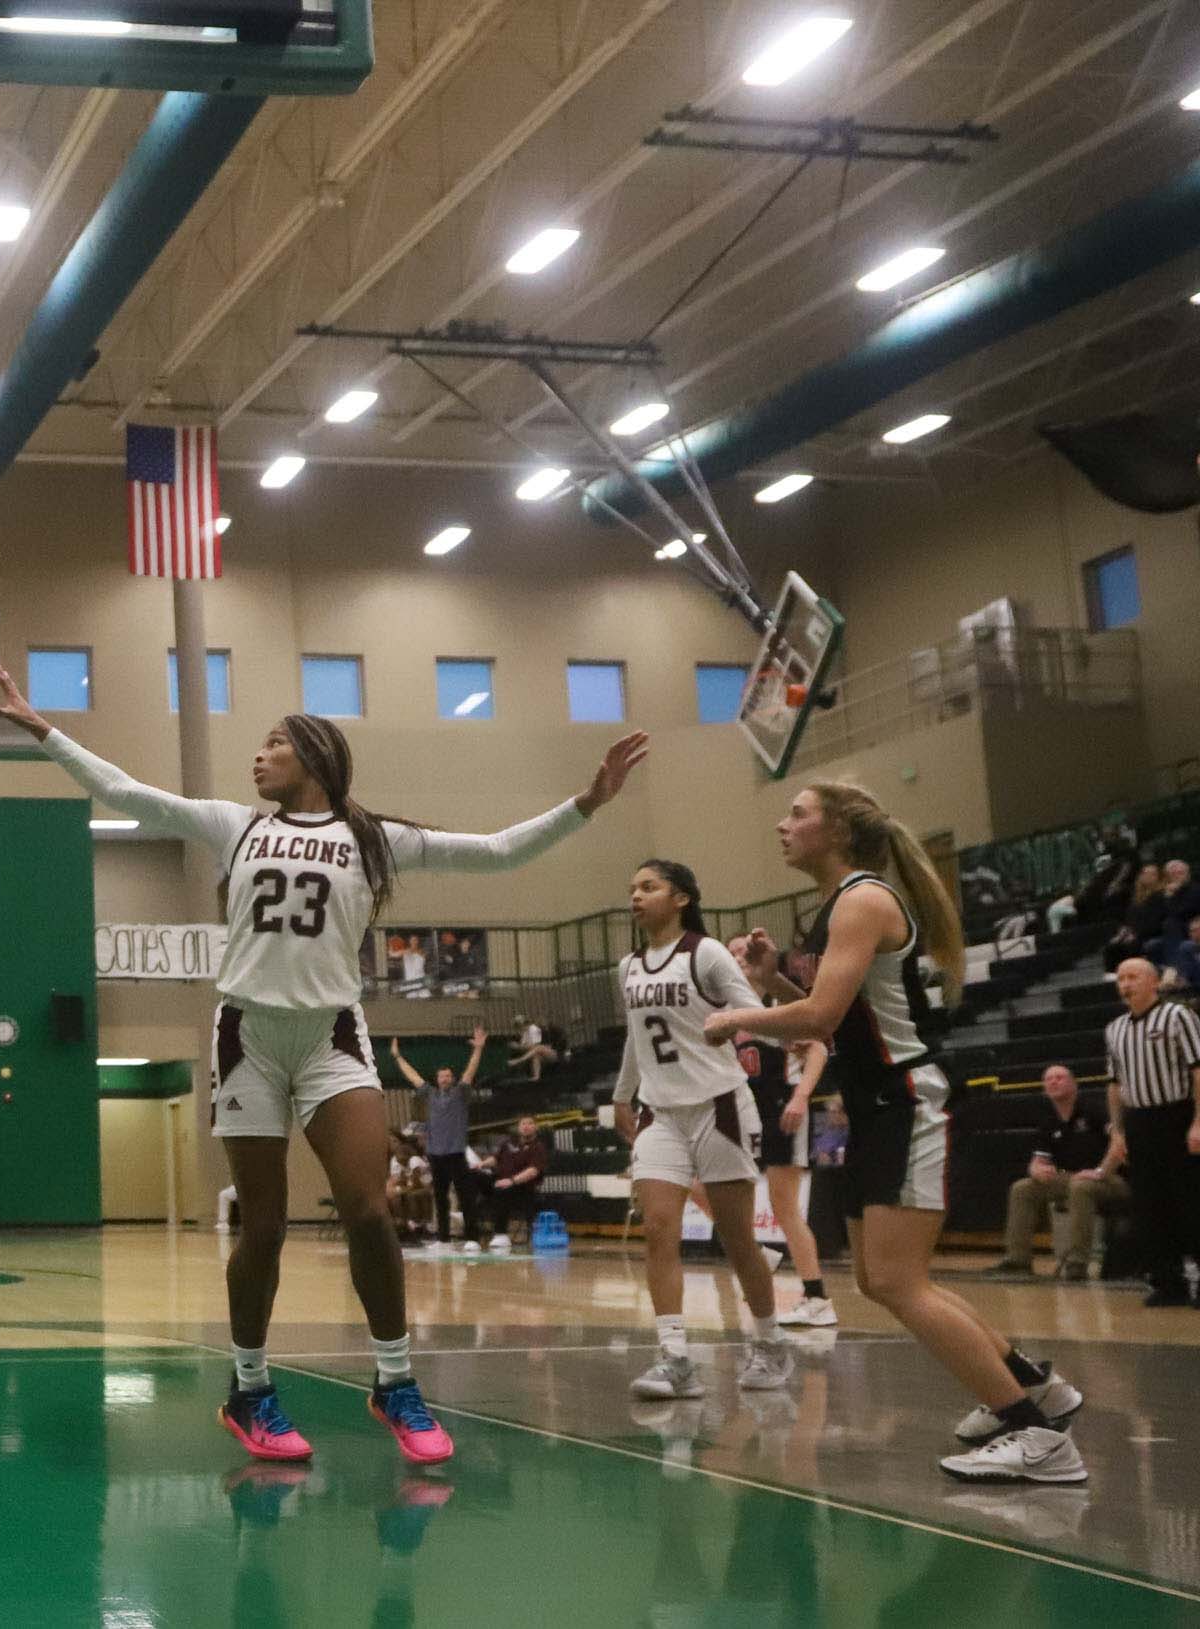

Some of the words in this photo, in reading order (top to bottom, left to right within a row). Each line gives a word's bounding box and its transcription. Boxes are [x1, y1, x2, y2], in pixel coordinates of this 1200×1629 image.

[244, 835, 352, 869] FALCONS
[252, 868, 331, 938] 23
[644, 1015, 679, 1065] 2
